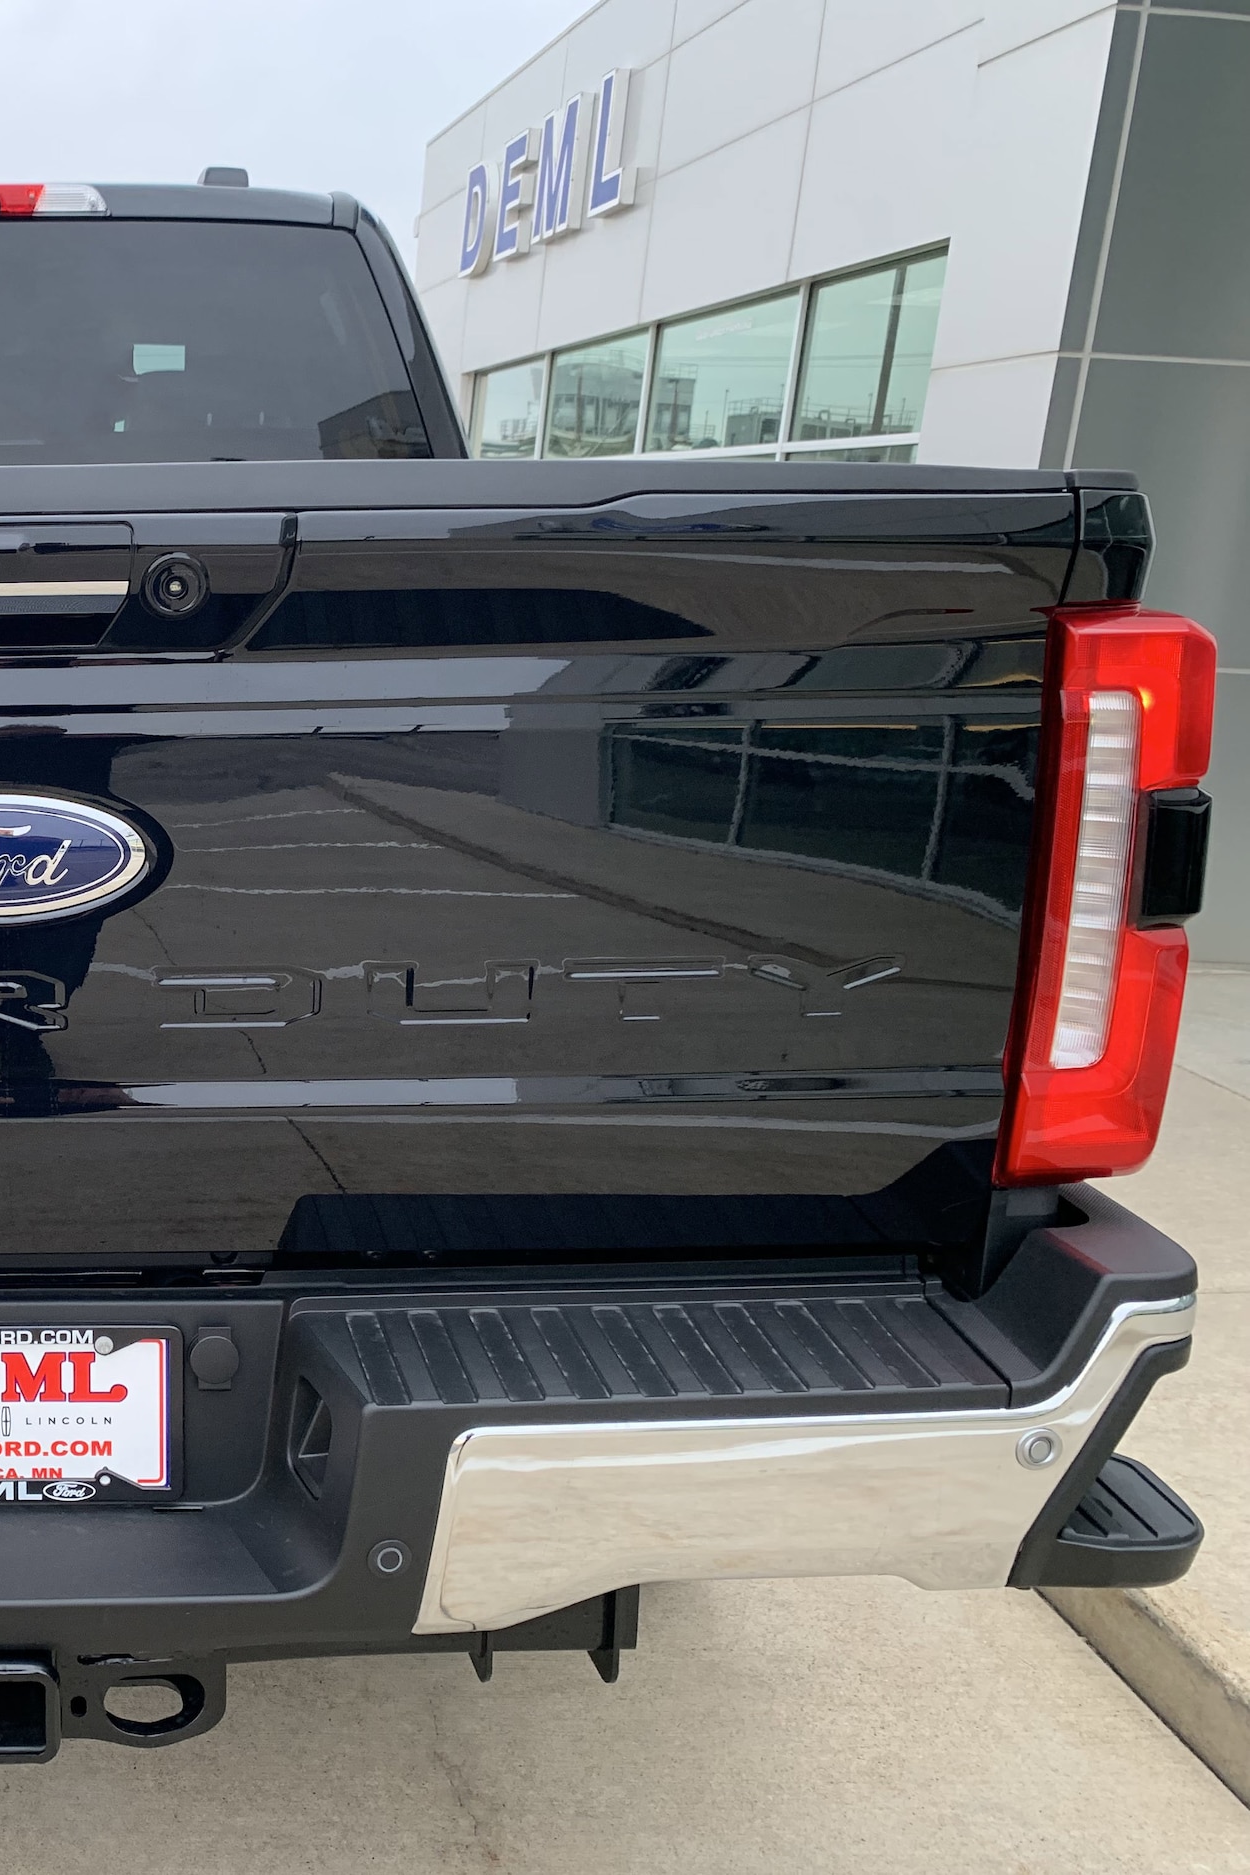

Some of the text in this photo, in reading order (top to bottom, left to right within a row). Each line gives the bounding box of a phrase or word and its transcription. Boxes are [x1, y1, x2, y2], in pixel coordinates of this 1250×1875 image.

[458, 68, 628, 278] DEML
[150, 955, 906, 1030] DUTY
[25, 1416, 113, 1426] LINCOLN
[31, 1467, 63, 1480] MN
[52, 1483, 86, 1498] Ford
